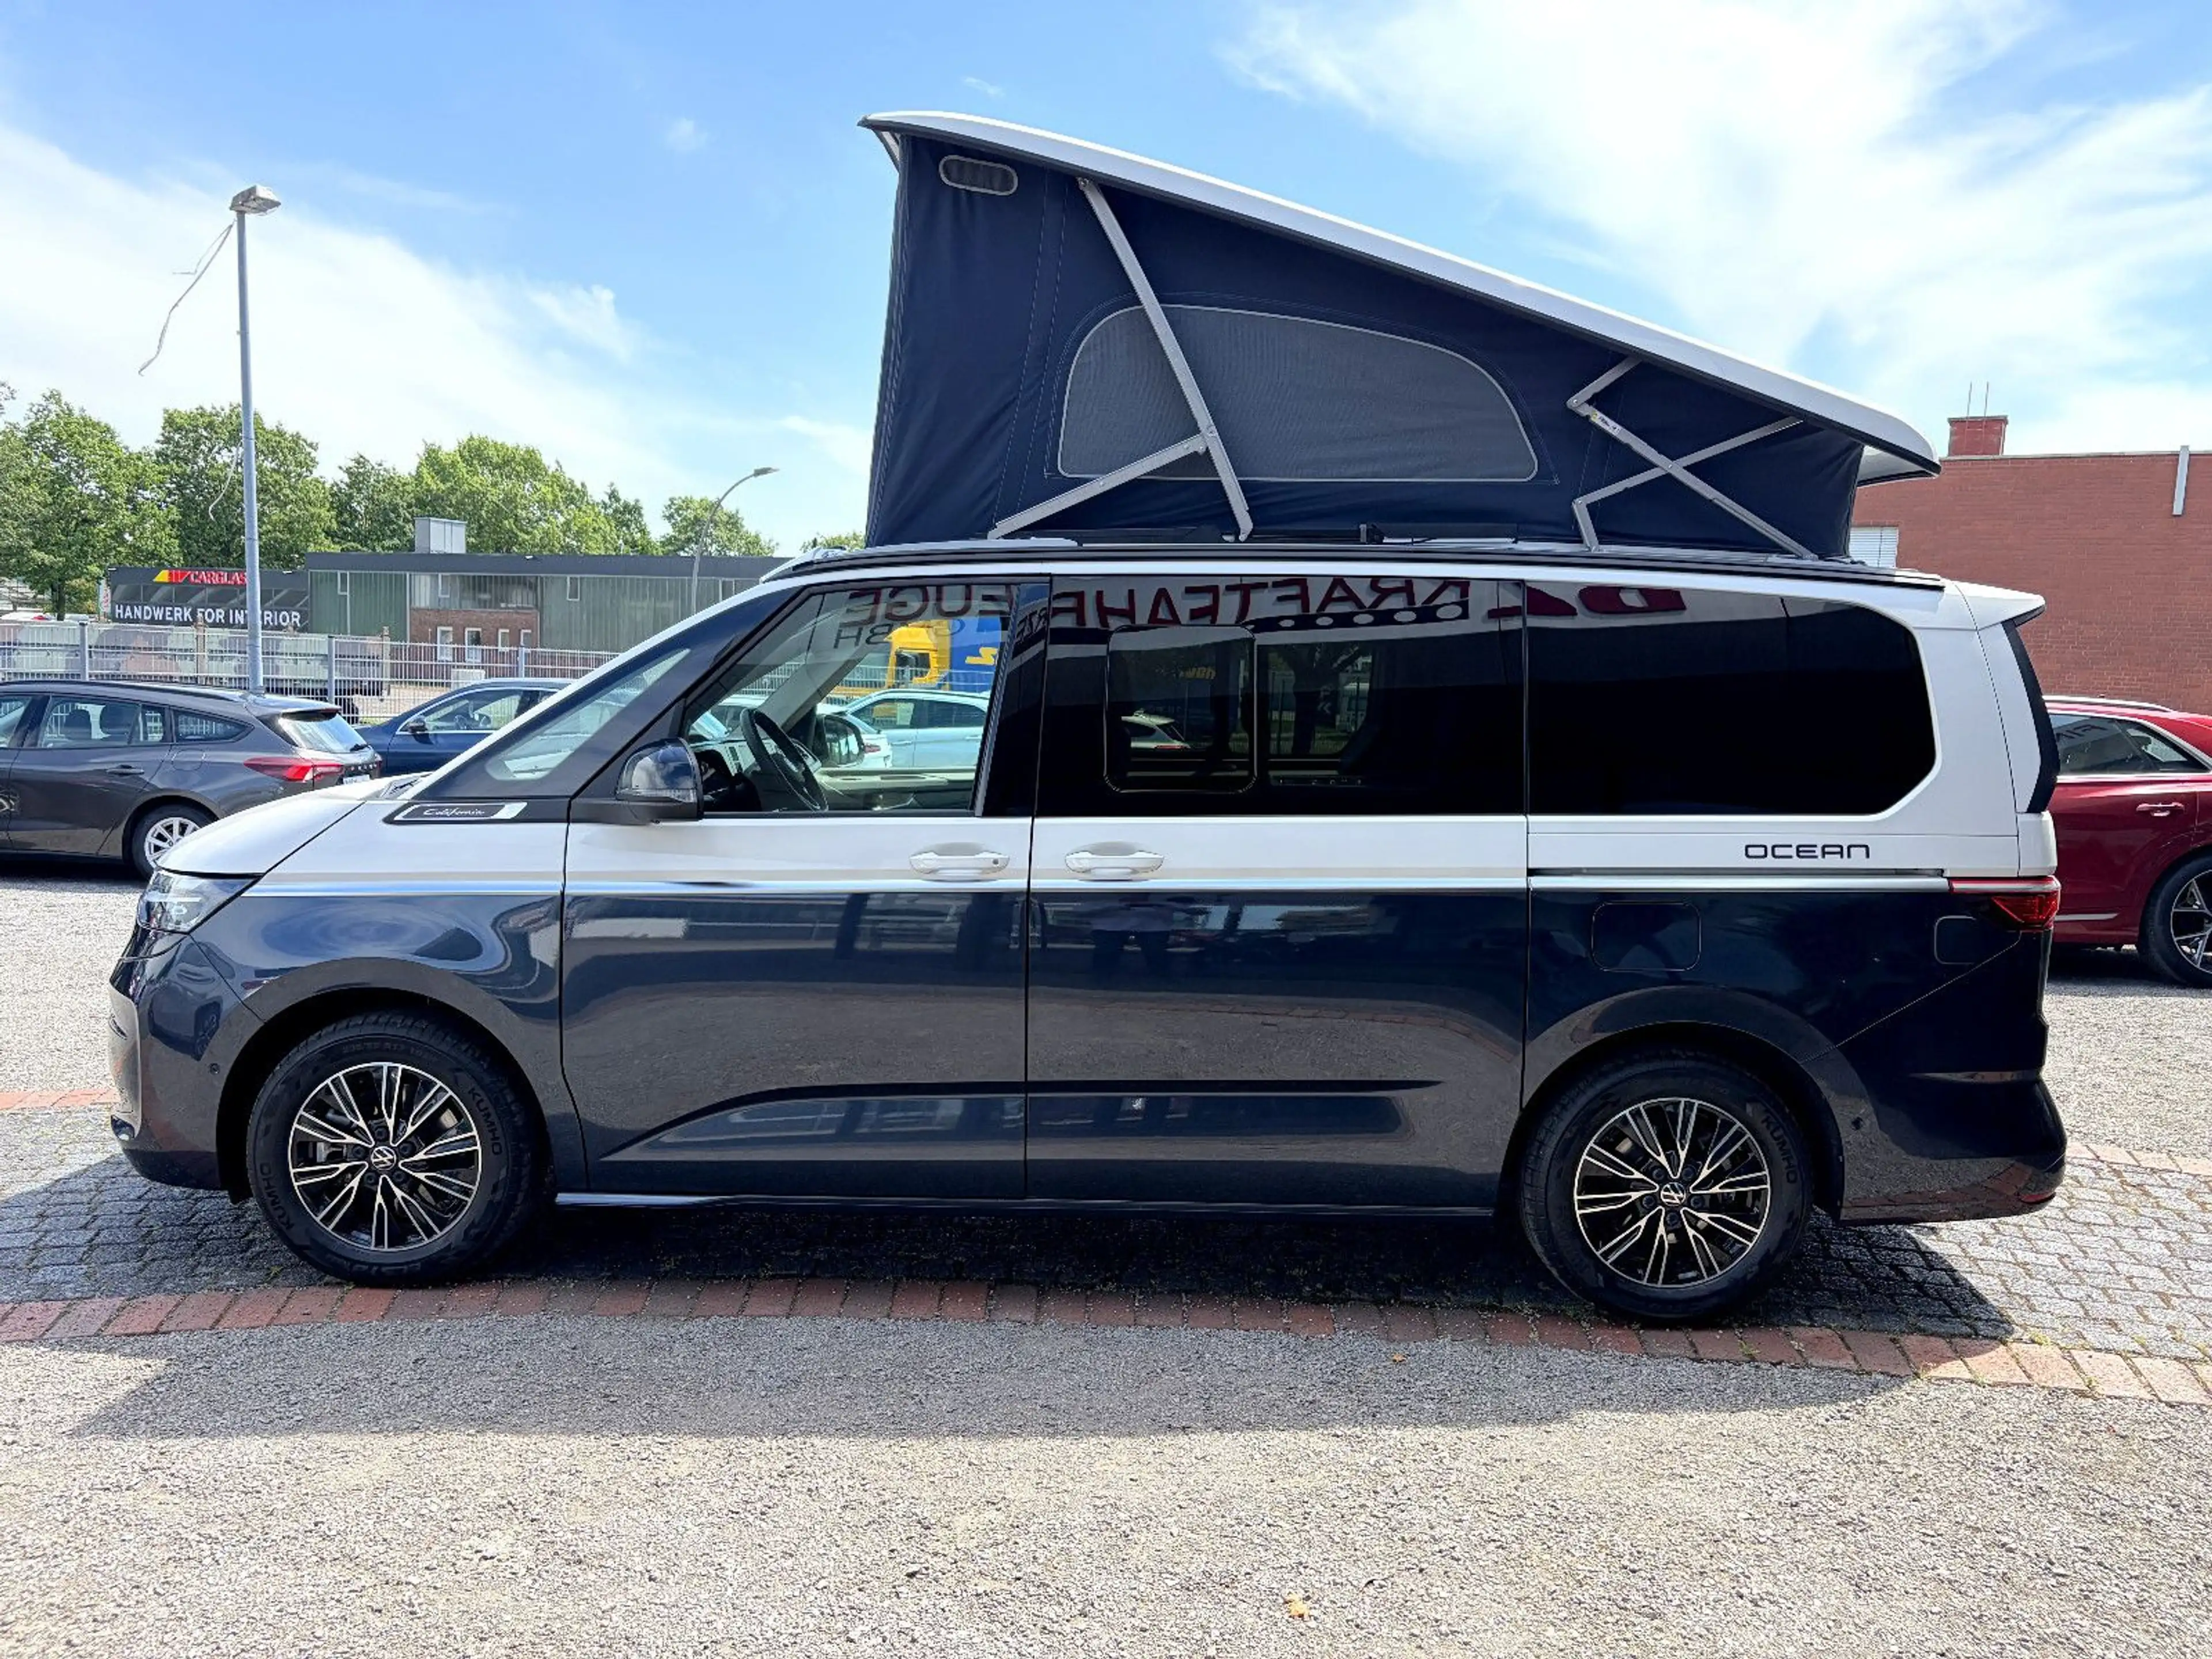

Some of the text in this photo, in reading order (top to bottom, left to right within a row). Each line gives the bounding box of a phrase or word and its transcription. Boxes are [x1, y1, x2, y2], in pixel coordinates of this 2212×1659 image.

[189, 570, 248, 584] CARGLAS
[116, 604, 300, 627] HANDWERK FOR INRIOR
[423, 807, 485, 816] California
[1744, 844, 1870, 859] OCEAN
[468, 1087, 503, 1156] KUMHO
[1761, 1115, 1798, 1184] KUMHO
[260, 1162, 294, 1230] KUMHO
